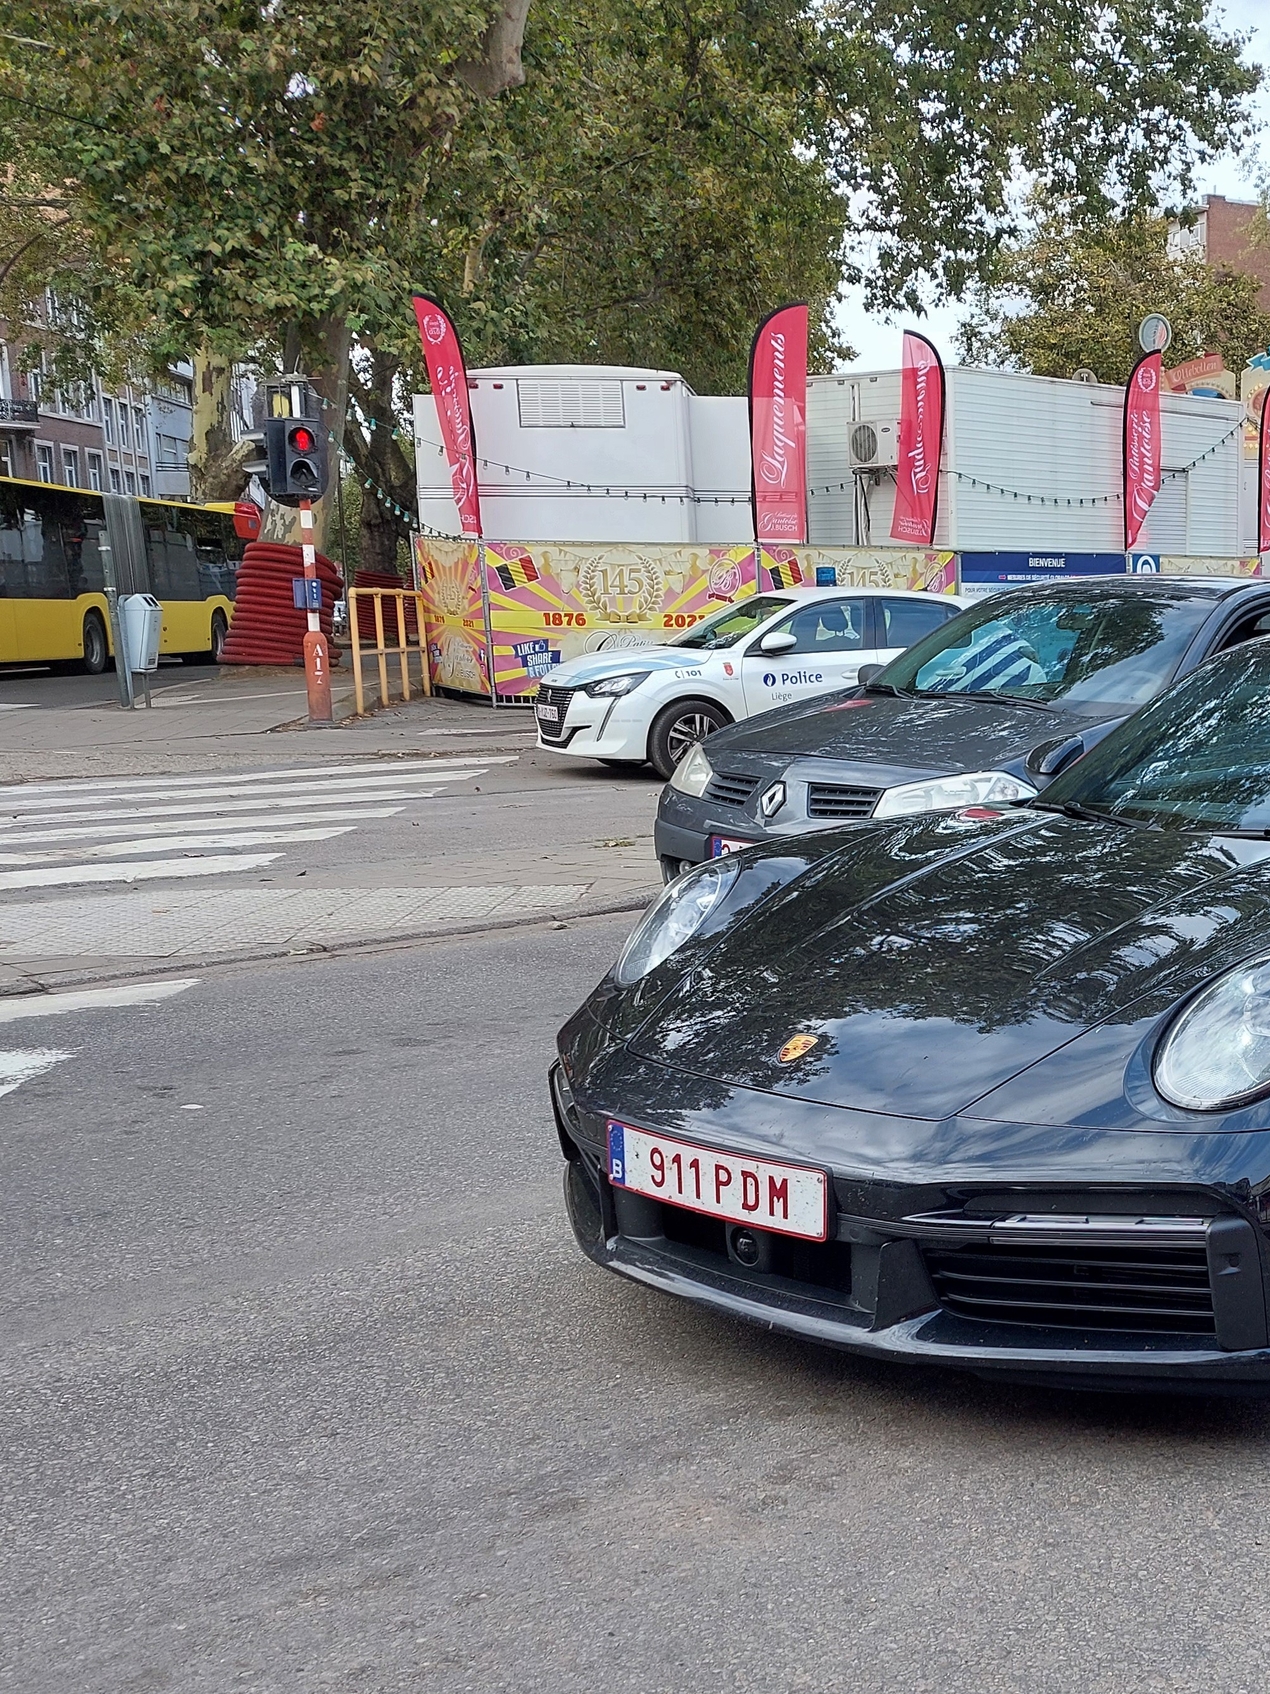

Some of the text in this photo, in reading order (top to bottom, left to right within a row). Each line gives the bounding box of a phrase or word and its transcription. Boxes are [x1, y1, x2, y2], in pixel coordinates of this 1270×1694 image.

[760, 331, 796, 489] Laquements
[1028, 557, 1066, 568] BIENVENUE
[600, 566, 644, 596] 145
[543, 612, 587, 627] 1876
[516, 641, 535, 656] LIKE
[527, 652, 553, 667] SHARE
[685, 669, 702, 677] 101
[781, 670, 823, 686] Police
[771, 691, 793, 702] Liège
[612, 1158, 623, 1179] B
